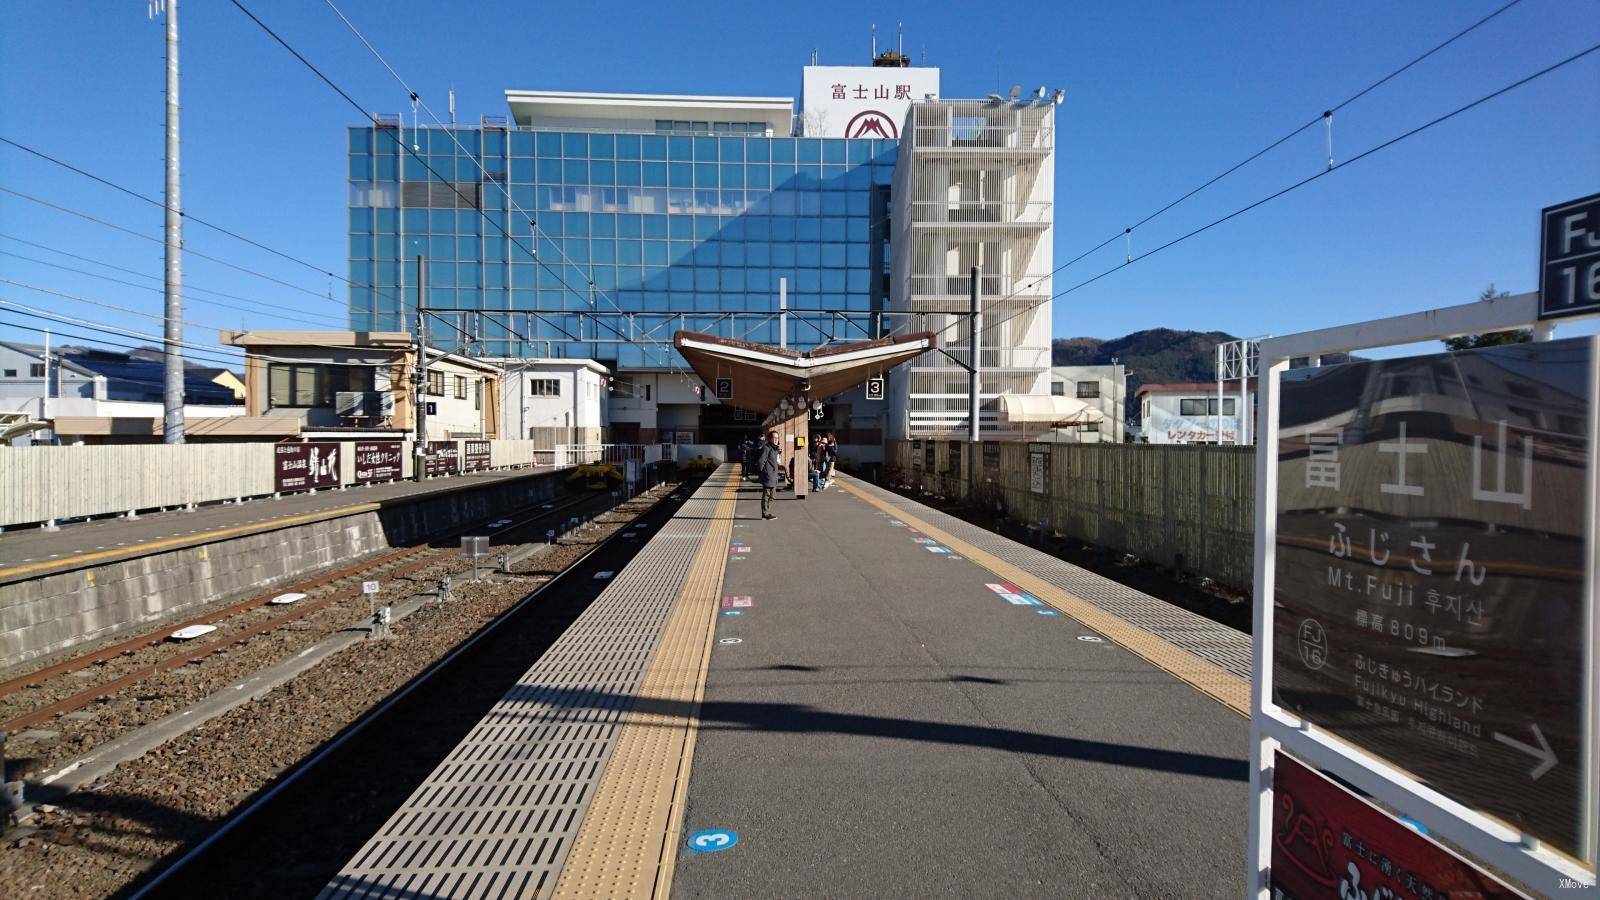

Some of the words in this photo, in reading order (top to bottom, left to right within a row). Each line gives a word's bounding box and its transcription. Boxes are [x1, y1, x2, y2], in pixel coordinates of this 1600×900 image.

[831, 83, 912, 100] 富士山駅
[719, 381, 729, 392] 2
[870, 381, 880, 393] 3
[1305, 419, 1534, 510] 富士山
[1329, 522, 1487, 586] ふじさん
[1424, 588, 1485, 627] 후지산
[1302, 625, 1323, 644] FJ
[1303, 645, 1323, 666] 16
[1355, 654, 1483, 715] ふじきゅうハイランド
[1355, 674, 1406, 706] Fujikyu
[1413, 699, 1481, 737] Highland
[696, 833, 730, 847] 3
